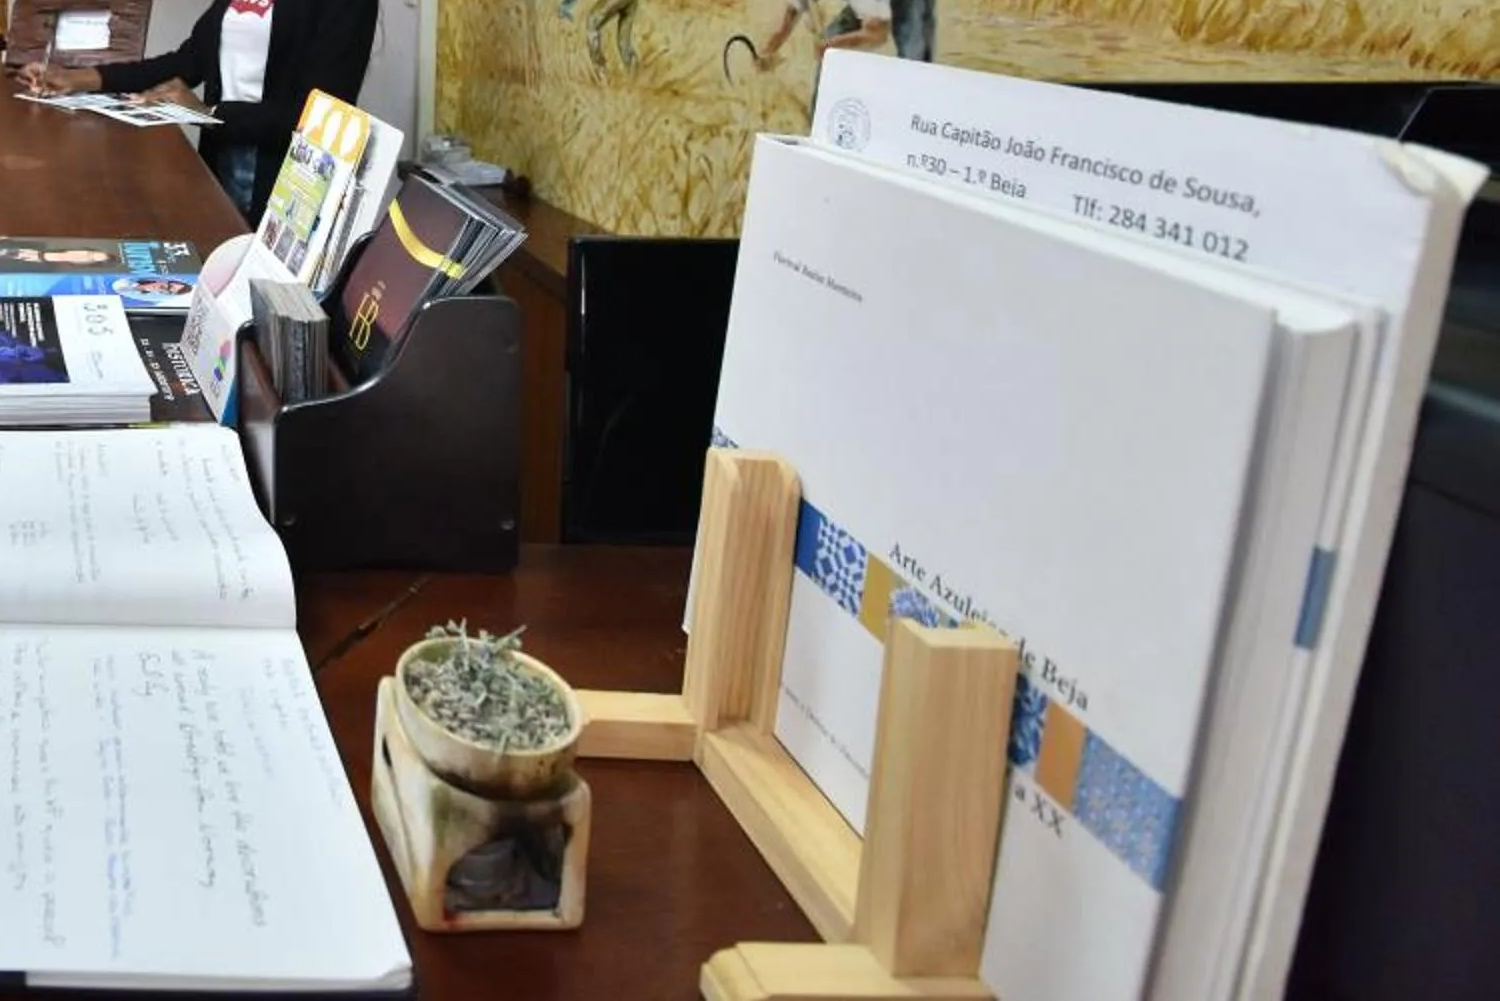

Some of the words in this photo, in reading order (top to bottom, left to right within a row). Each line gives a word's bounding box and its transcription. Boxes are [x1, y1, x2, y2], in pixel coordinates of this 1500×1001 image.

[910, 113, 938, 136] Rua
[941, 121, 1002, 150] Capitão
[1005, 136, 1046, 162] João
[1050, 146, 1144, 186] Francisco
[1149, 169, 1178, 194] de
[1182, 176, 1262, 218] Sousa,
[1073, 194, 1103, 221] Tlf:
[1108, 204, 1148, 233] 284
[1152, 216, 1195, 247] 341
[1201, 230, 1250, 262] 012
[888, 541, 926, 582] Arte
[1041, 655, 1089, 713] Beja
[1030, 791, 1065, 839] XX
